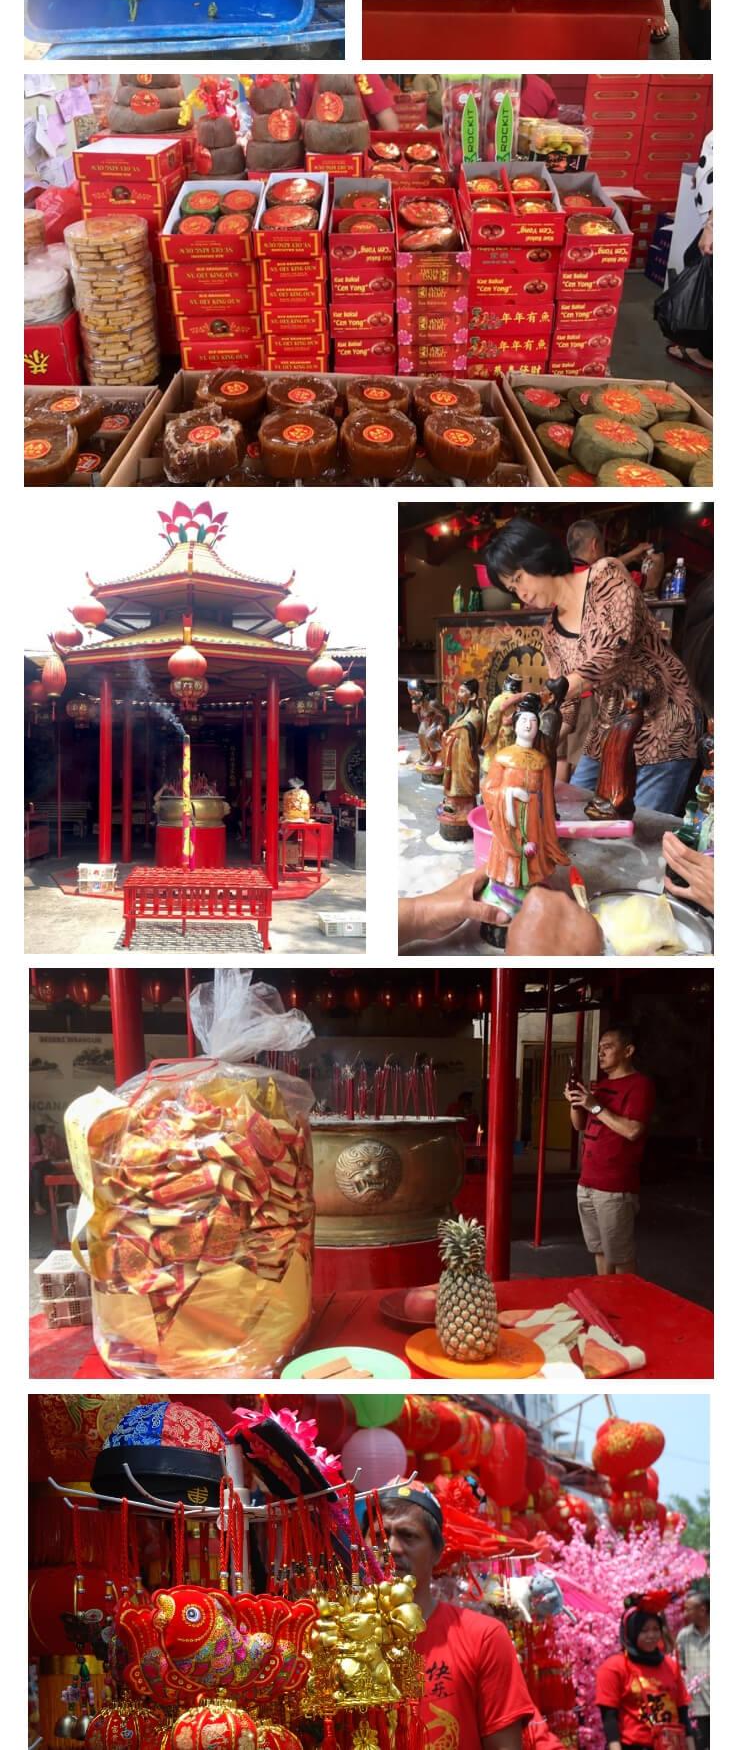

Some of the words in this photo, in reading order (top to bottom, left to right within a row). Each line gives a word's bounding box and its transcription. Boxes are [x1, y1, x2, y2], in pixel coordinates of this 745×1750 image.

[467, 109, 475, 152] ROCKIT
[501, 108, 509, 152] ROCKIT
[502, 311, 550, 323] 年年有魚
[498, 339, 547, 351] 年年有魚
